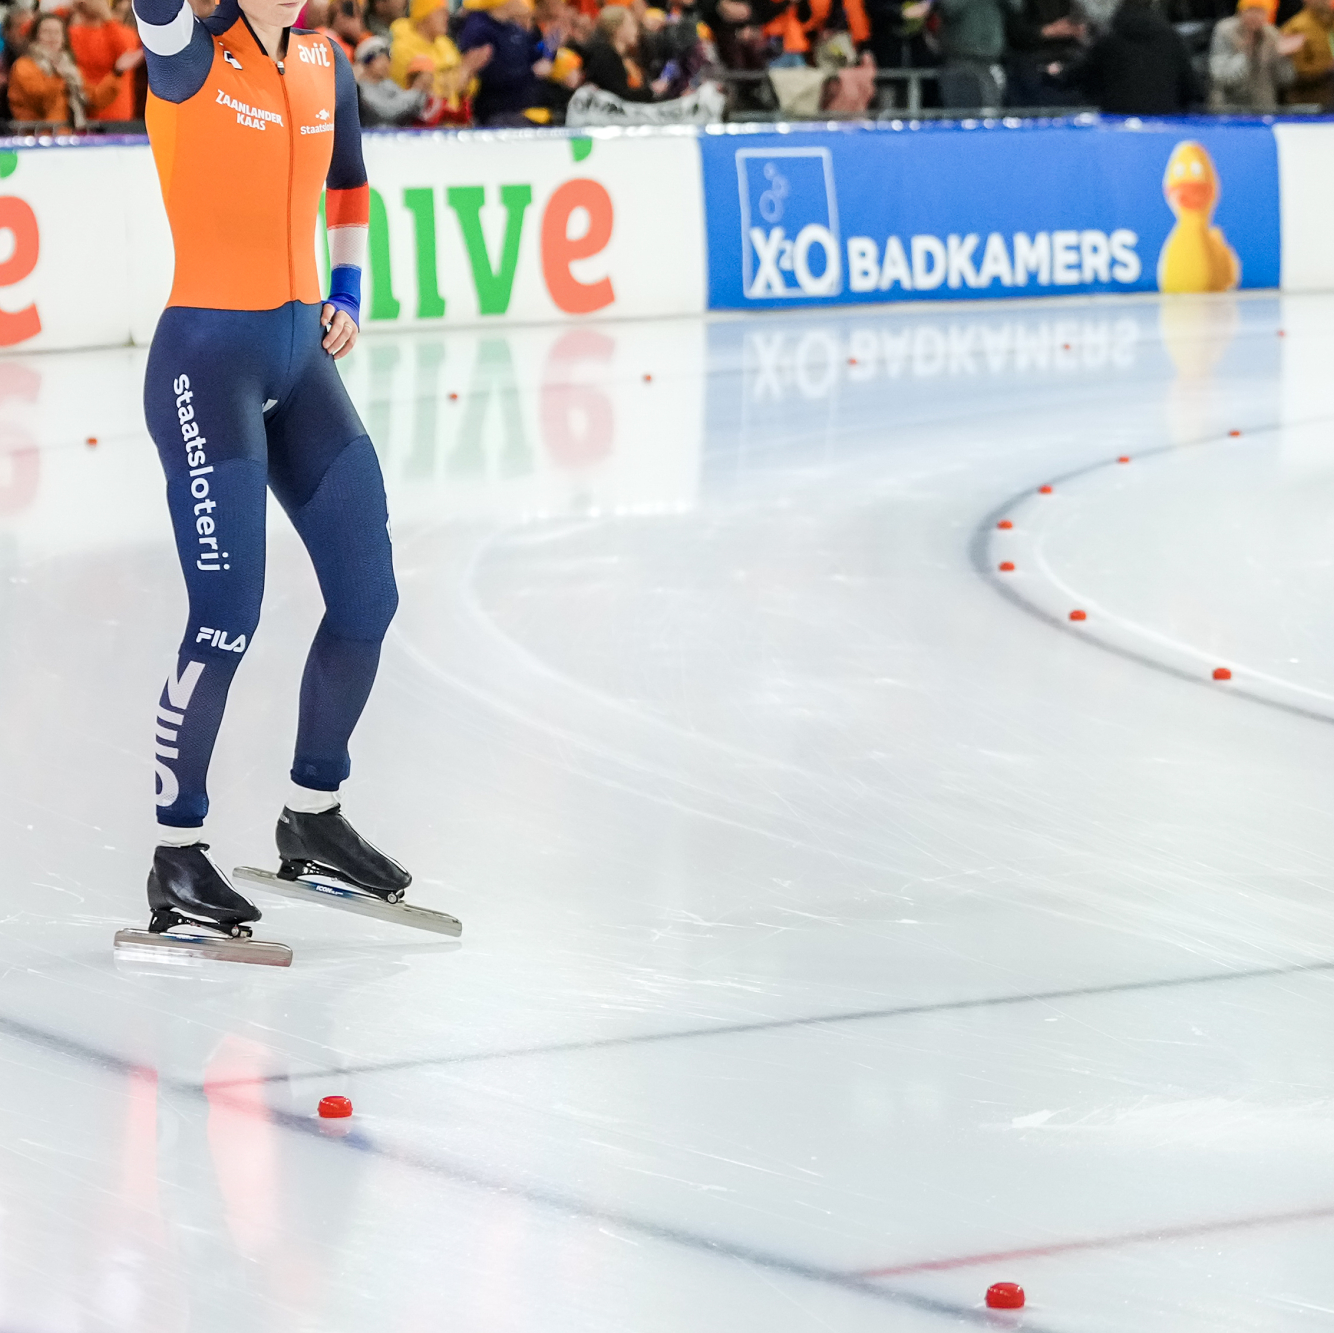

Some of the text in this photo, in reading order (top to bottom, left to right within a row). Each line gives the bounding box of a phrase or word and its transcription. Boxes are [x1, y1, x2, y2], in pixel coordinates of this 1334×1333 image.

[298, 42, 331, 68] avit
[215, 89, 284, 127] ZAANLANDER
[237, 112, 266, 131] KAAS
[847, 229, 1142, 293] BADKAMERS
[173, 373, 230, 571] staatsloterij
[196, 626, 247, 653] FILA
